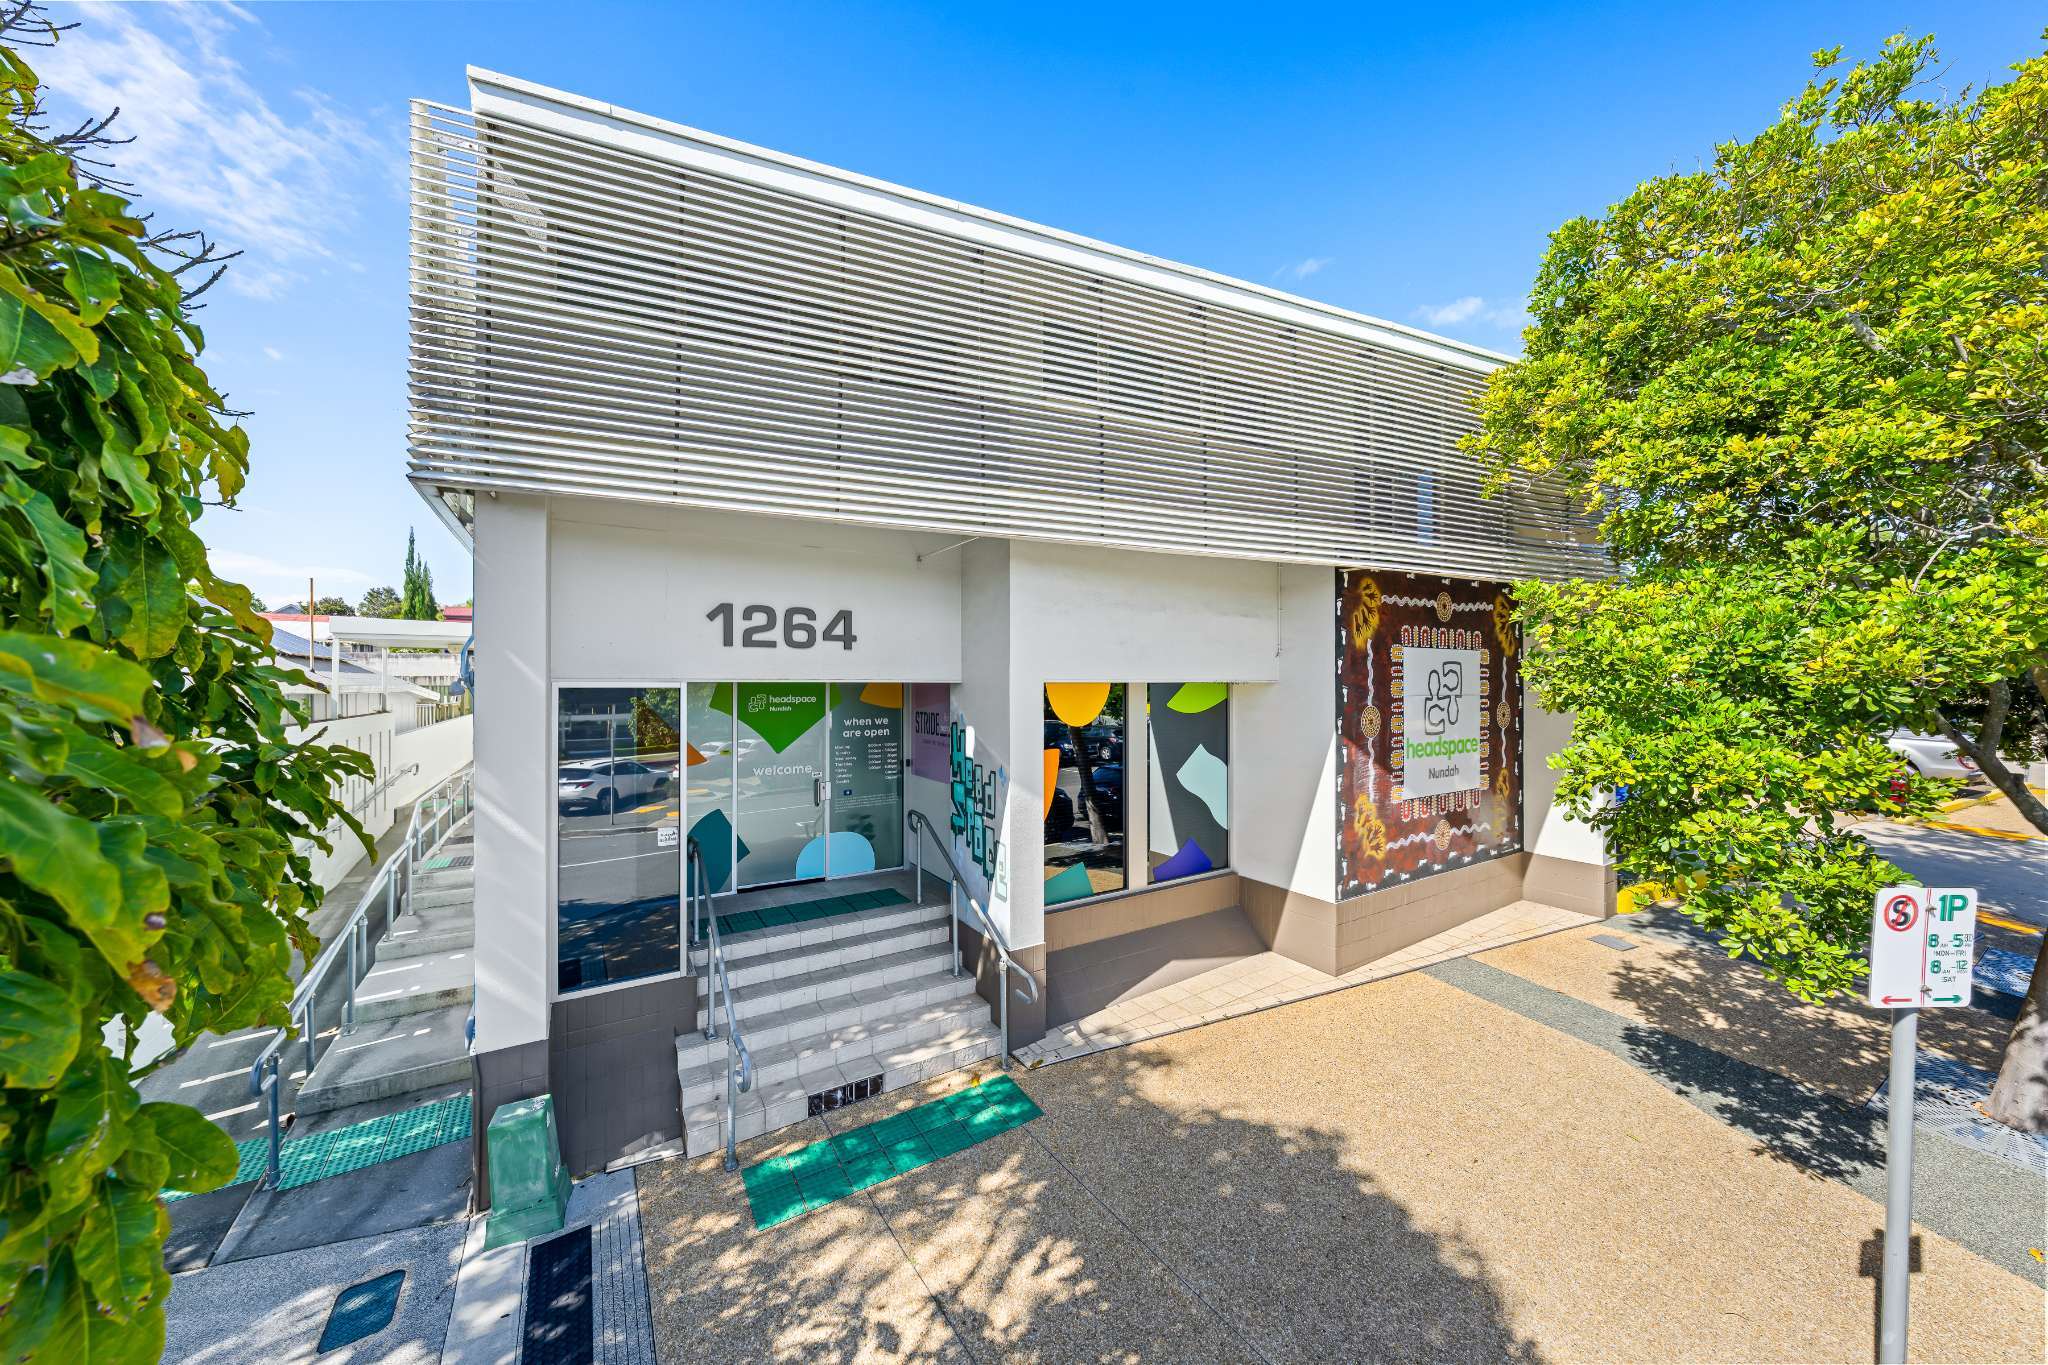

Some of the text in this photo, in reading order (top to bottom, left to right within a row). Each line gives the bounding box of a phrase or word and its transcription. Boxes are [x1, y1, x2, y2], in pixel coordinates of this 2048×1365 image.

[706, 602, 857, 650] 1264
[769, 694, 817, 705] headspace
[843, 718, 872, 726] when
[915, 711, 940, 736] STRIDE
[843, 728, 890, 738] are open
[1406, 736, 1479, 761] headspace
[753, 764, 813, 776] welcome
[1428, 765, 1460, 780] Nundah
[1938, 894, 1969, 921] 1P
[1928, 933, 1939, 948] 8
[1930, 960, 1942, 974] 8
